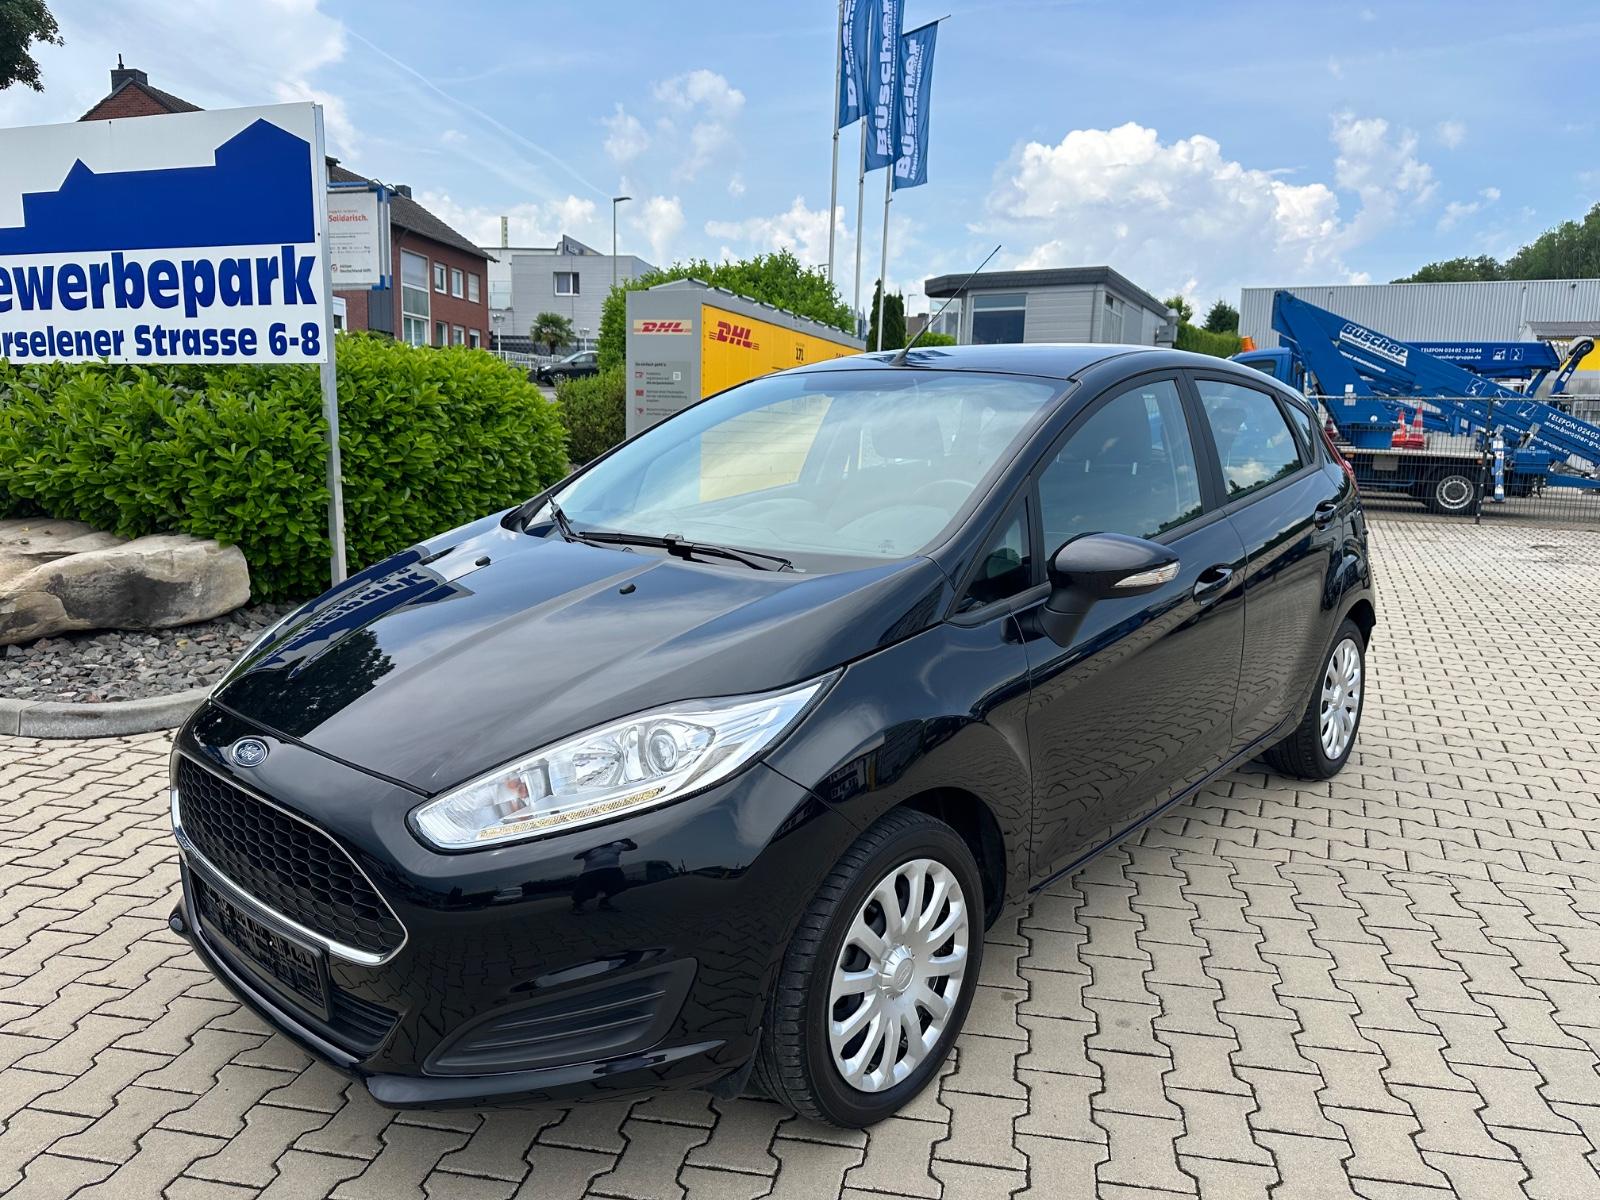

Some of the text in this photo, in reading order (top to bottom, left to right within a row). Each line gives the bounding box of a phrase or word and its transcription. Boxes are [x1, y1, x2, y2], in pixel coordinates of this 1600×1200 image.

[895, 39, 917, 178] Büscher
[328, 214, 368, 223] Solidarisch.
[0, 322, 320, 357] rselener Strasse 6-8
[642, 322, 683, 333] DHL
[716, 320, 753, 349] DHL
[1342, 322, 1408, 357] Büscher
[1547, 412, 1578, 430] TELEFON
